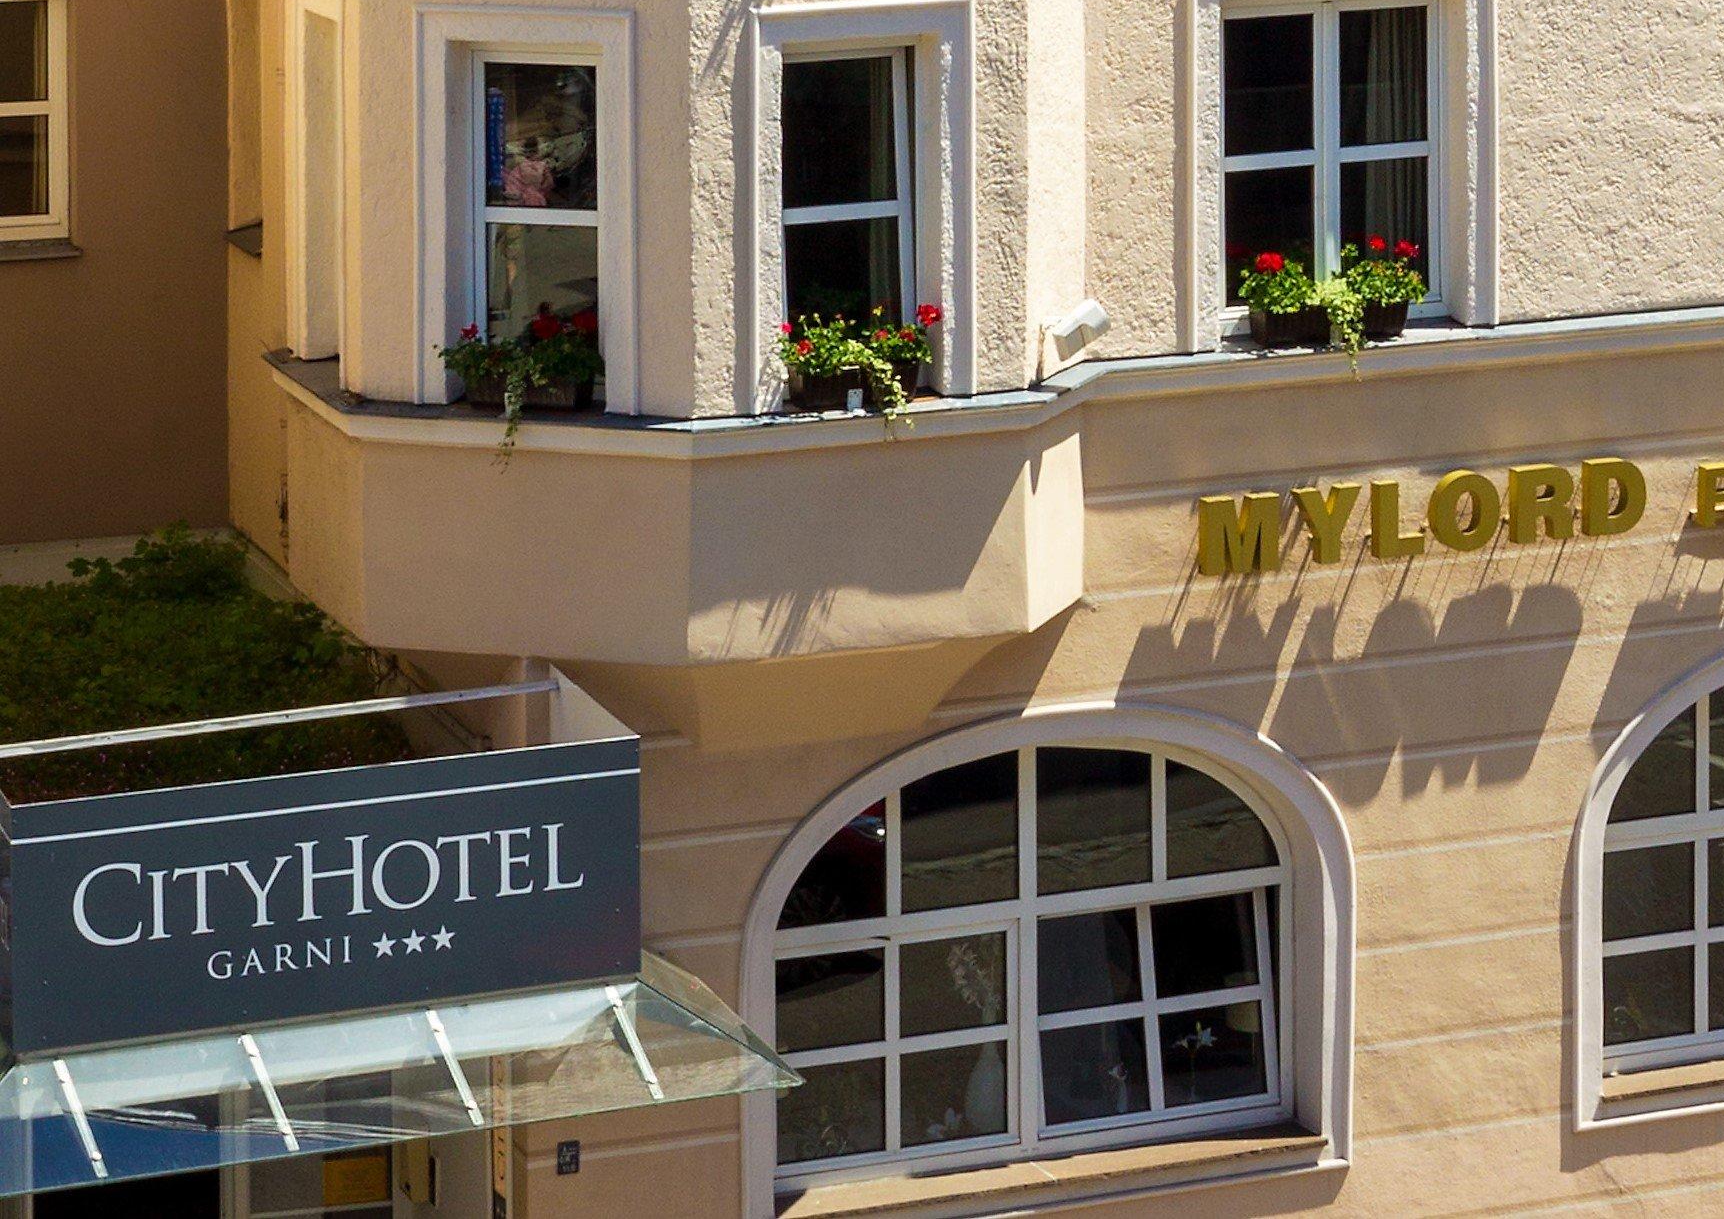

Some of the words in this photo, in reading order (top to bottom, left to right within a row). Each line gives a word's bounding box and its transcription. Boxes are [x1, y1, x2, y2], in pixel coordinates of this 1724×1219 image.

[1199, 458, 1647, 576] MYLORD
[73, 823, 584, 947] CITYHOTEL
[207, 936, 353, 980] GARNI
